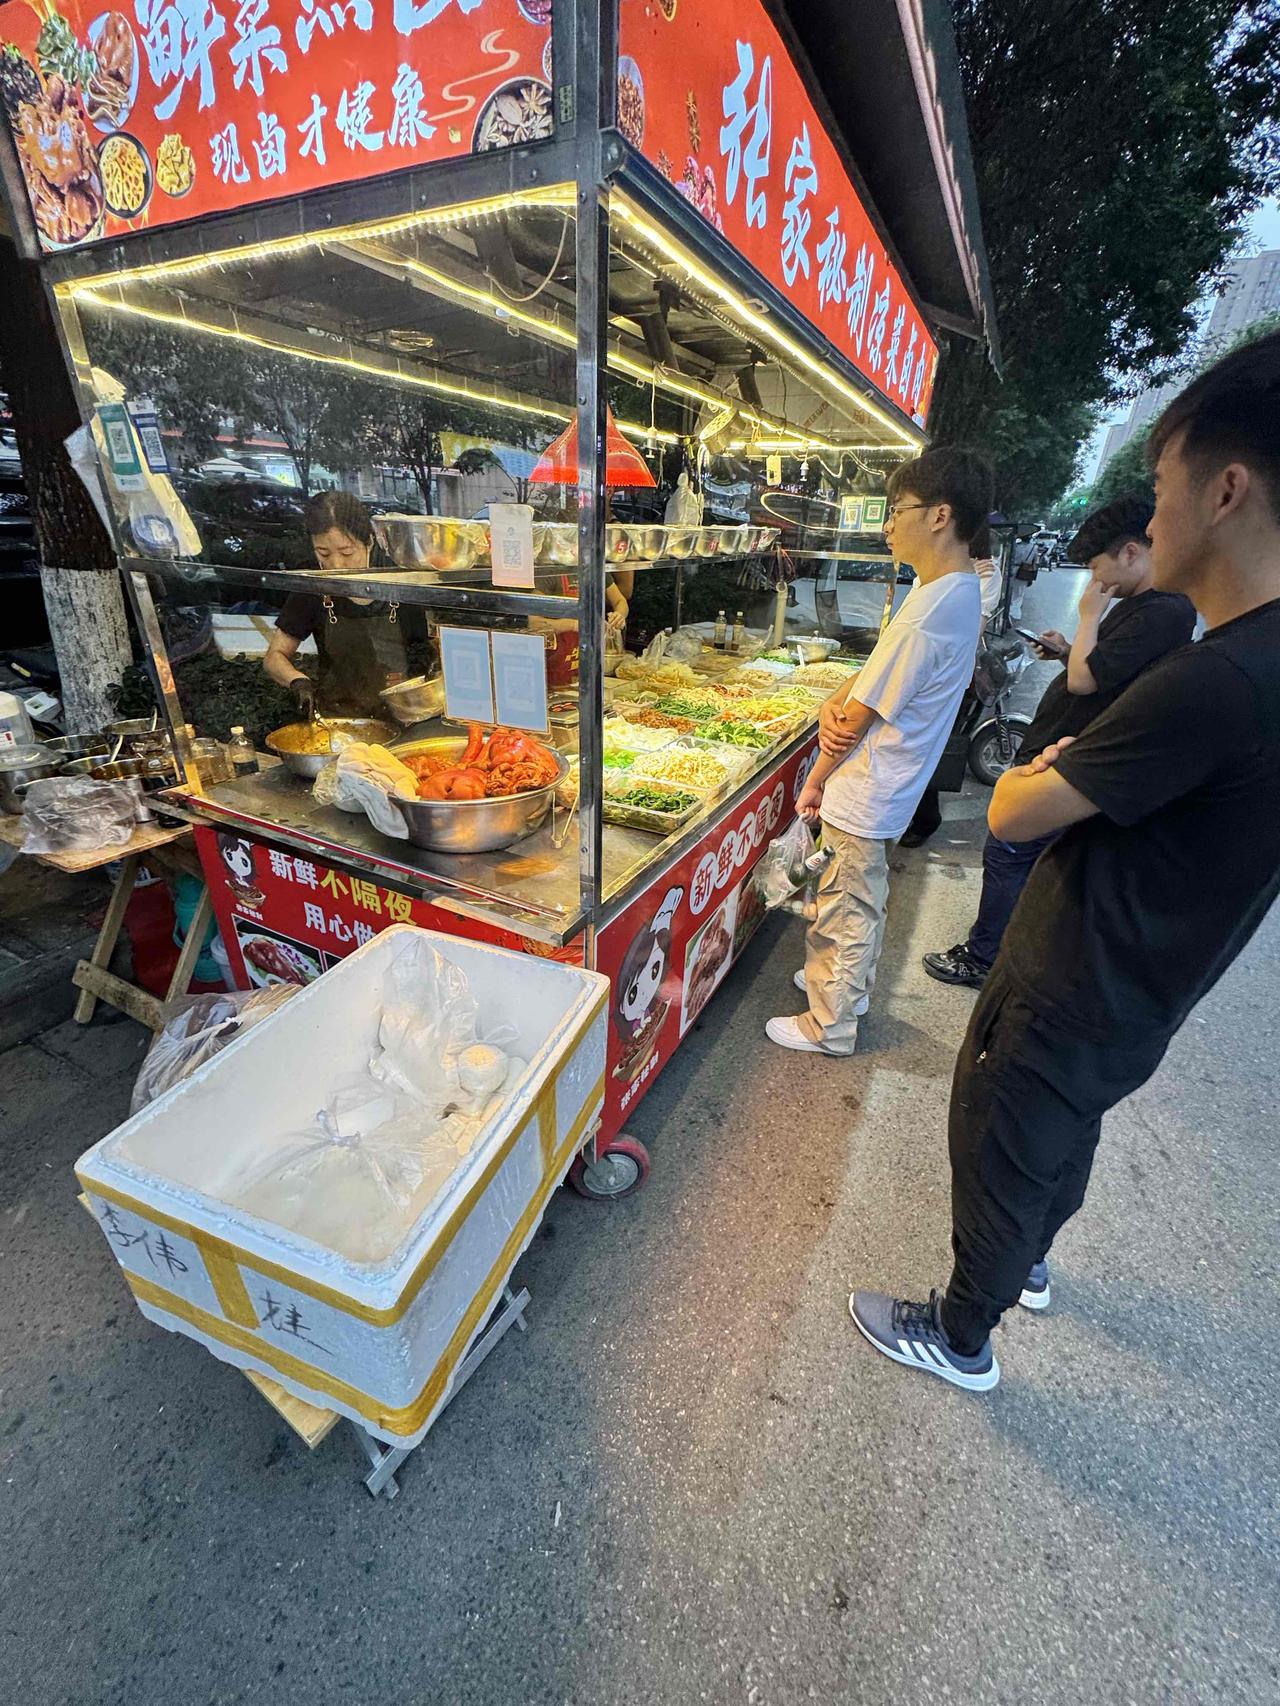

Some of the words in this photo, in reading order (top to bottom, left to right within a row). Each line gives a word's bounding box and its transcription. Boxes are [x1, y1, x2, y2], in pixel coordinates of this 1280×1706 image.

[210, 63, 437, 184] 现卤才健康
[719, 38, 927, 412] 张家秘制凉菜卤肉
[267, 847, 418, 926] 新鲜不隔夜
[692, 787, 784, 909] 新鲜不隔夜
